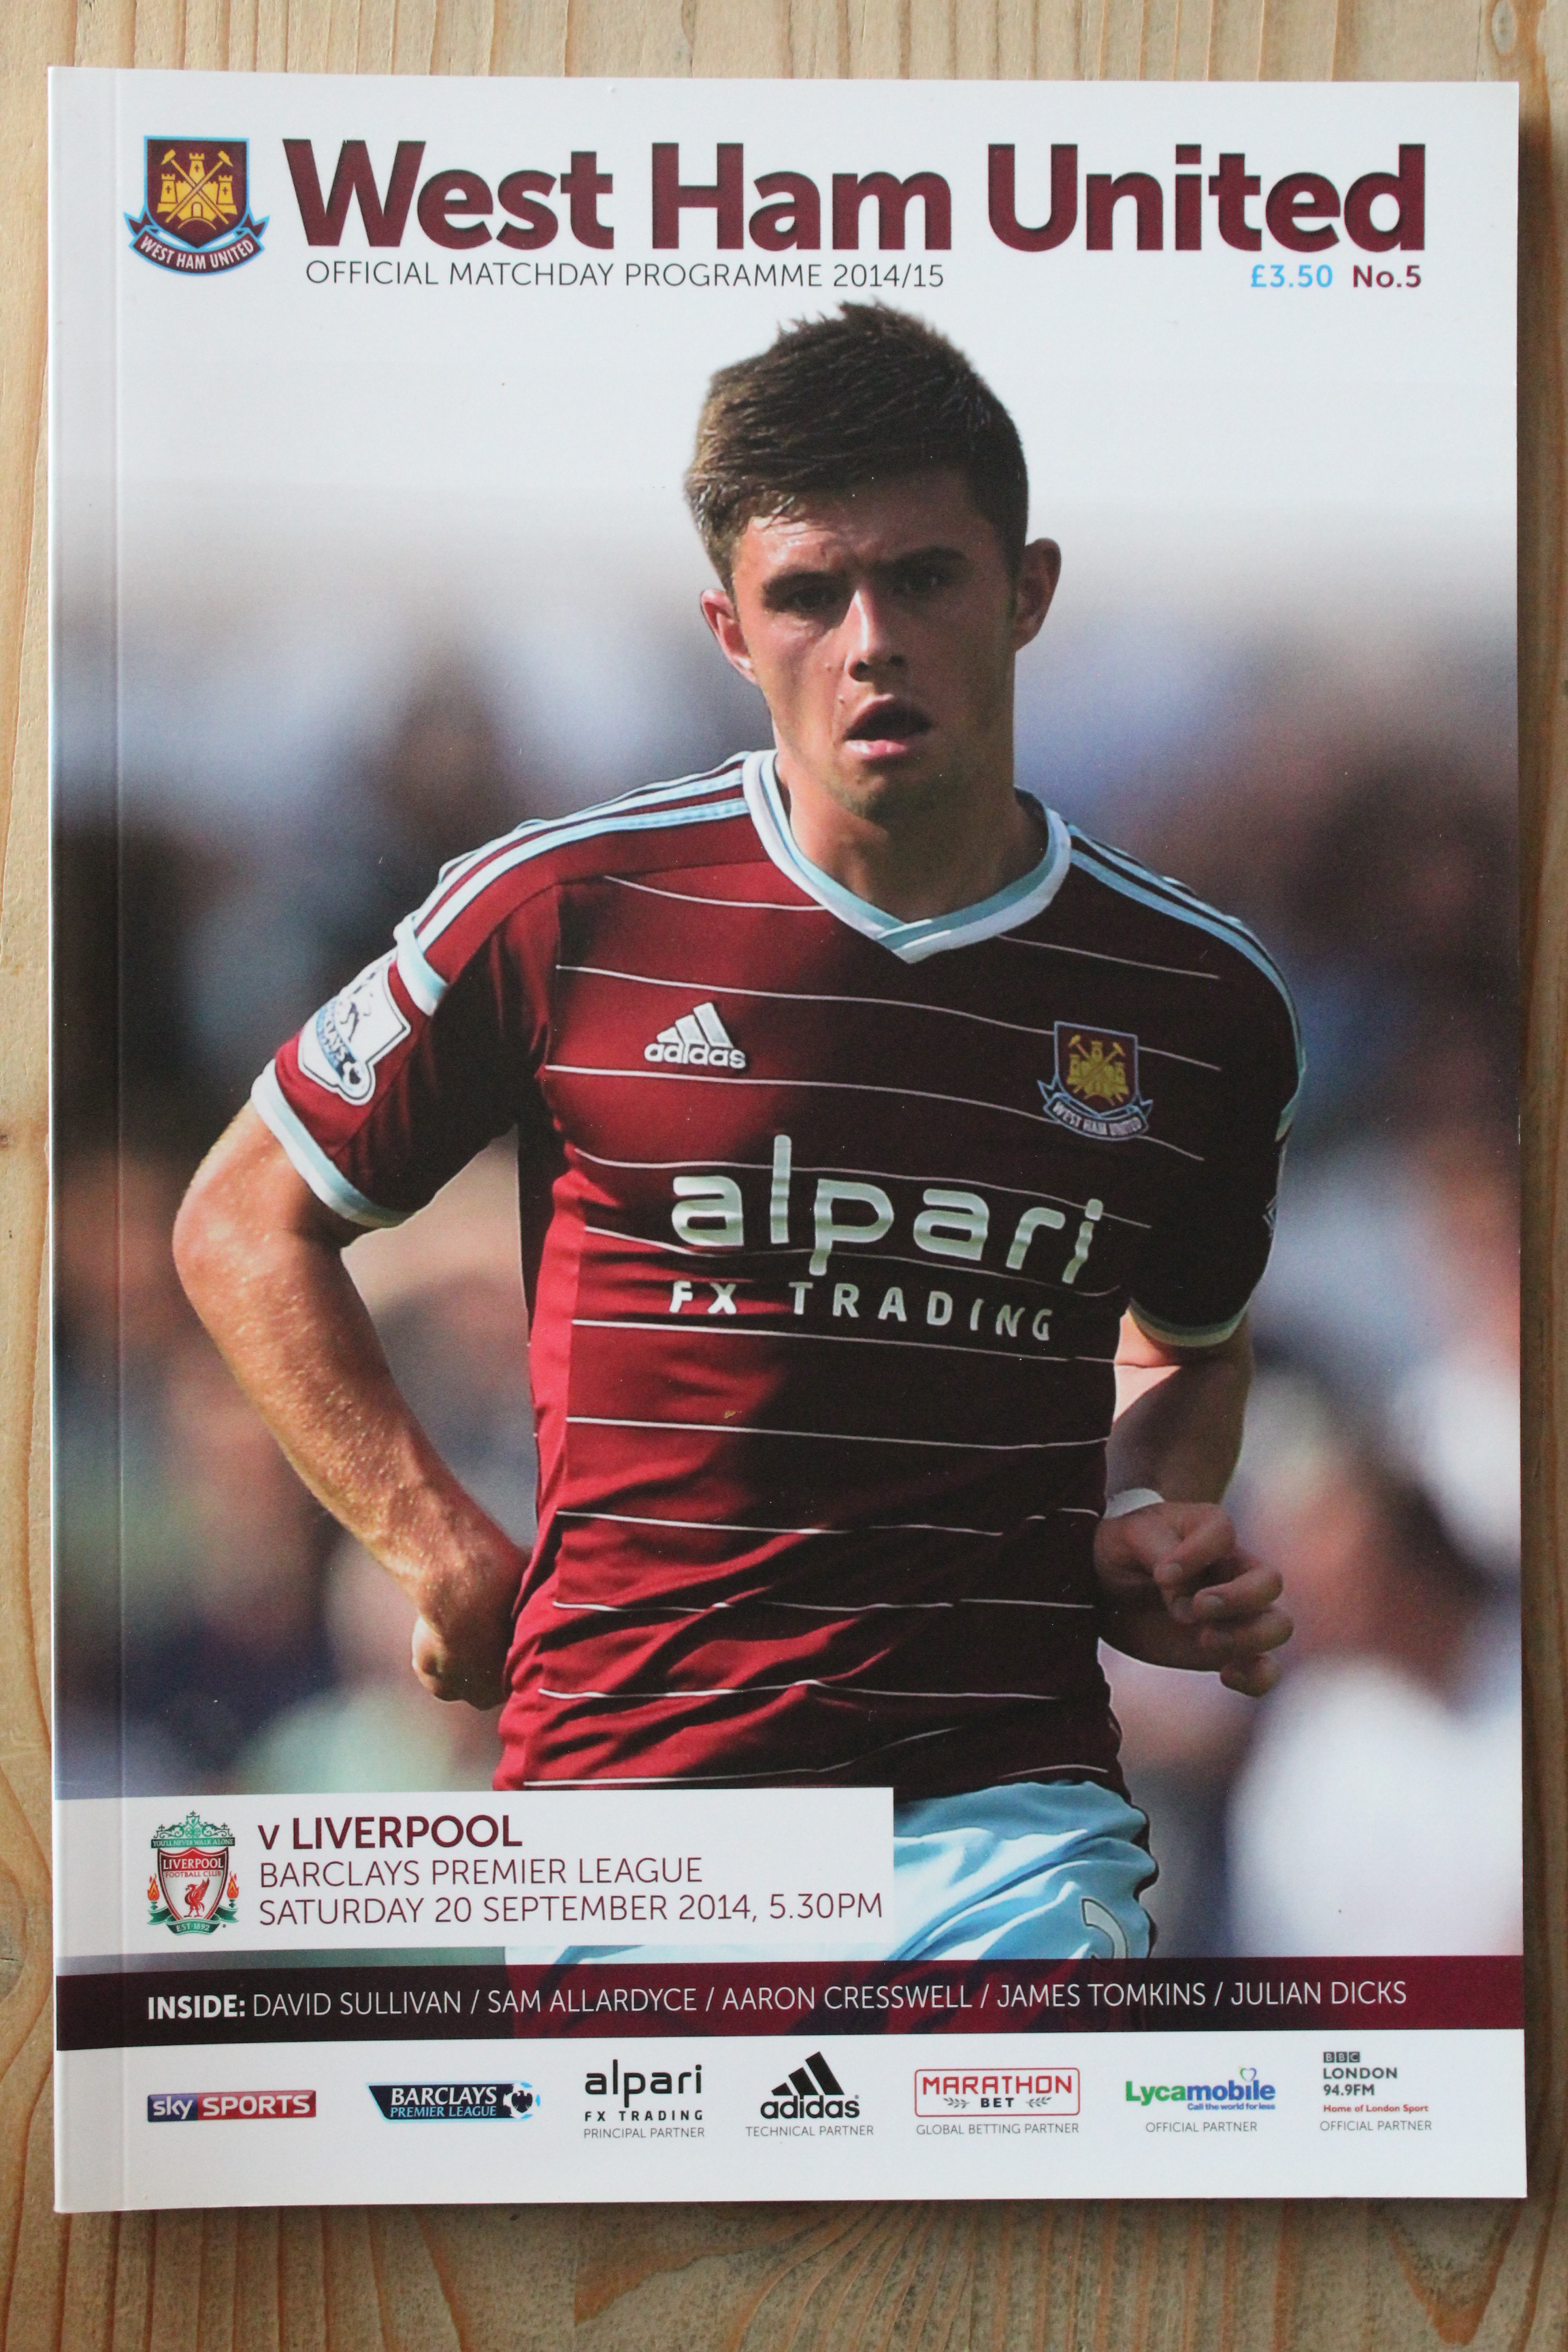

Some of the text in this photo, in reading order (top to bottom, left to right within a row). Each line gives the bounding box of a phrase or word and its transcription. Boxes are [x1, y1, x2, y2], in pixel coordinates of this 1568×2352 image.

[282, 138, 1426, 252] West Ham United
[140, 235, 255, 270] WEST HAM UNITED
[306, 260, 944, 289] OFFICIAL MATCHDAY PROGRAMME 2014/15
[1250, 263, 1422, 288] £3.50 No.5
[644, 1041, 747, 1069] adidas
[671, 1134, 1104, 1284] alpari
[669, 1279, 1053, 1341] FX TRADING
[258, 1814, 523, 1850] v LIVERPOOL
[163, 1858, 224, 1869] LIVERPOOL
[260, 1857, 703, 1888] BARCLAYS PREMIER LEAGUE
[259, 1893, 883, 1926] SATURDAY 20 SEPTEMBER 2014, 5.30PM
[148, 1995, 246, 2020] INSIDE:
[253, 1993, 331, 2017] DAVID
[340, 1991, 462, 2016] SULLIVAN
[488, 1990, 542, 2013] SAM
[549, 1989, 696, 2012] ALLARDYCE
[721, 1987, 815, 2011] AARON
[823, 1985, 974, 2010] CRESSWELL
[997, 1984, 1081, 2008] JAMES
[1088, 1982, 1206, 2007] TOMKINS
[1231, 1982, 1322, 2006] JULIAN
[1331, 1981, 1407, 2005] DICKS
[1325, 2052, 1360, 2063] BBC
[585, 2059, 702, 2108] alpari
[923, 2075, 1072, 2095] MARATHON
[1323, 2068, 1398, 2080] LONDON
[391, 2087, 497, 2106] BARCLAYS
[1125, 2080, 1276, 2106] Lycamobile
[1323, 2084, 1375, 2096] 94.9FM
[153, 2095, 310, 2119] sky SPORTS
[391, 2106, 497, 2117] PREMIER LEAGUE
[760, 2095, 860, 2119] adidas
[981, 2097, 1015, 2108] BET
[1323, 2104, 1428, 2114] Home of London Sport
[585, 2110, 702, 2121] FX TRADING
[1320, 2120, 1432, 2131] OFFICIAL PARTNER
[584, 2127, 705, 2139] PRINCIPAL PARTNER
[745, 2125, 875, 2137] TECHNICAL PARTNER
[916, 2123, 1079, 2135] GLOBAL BETTING PARTNER
[1145, 2121, 1258, 2133] OFFICIAL PARTNER
